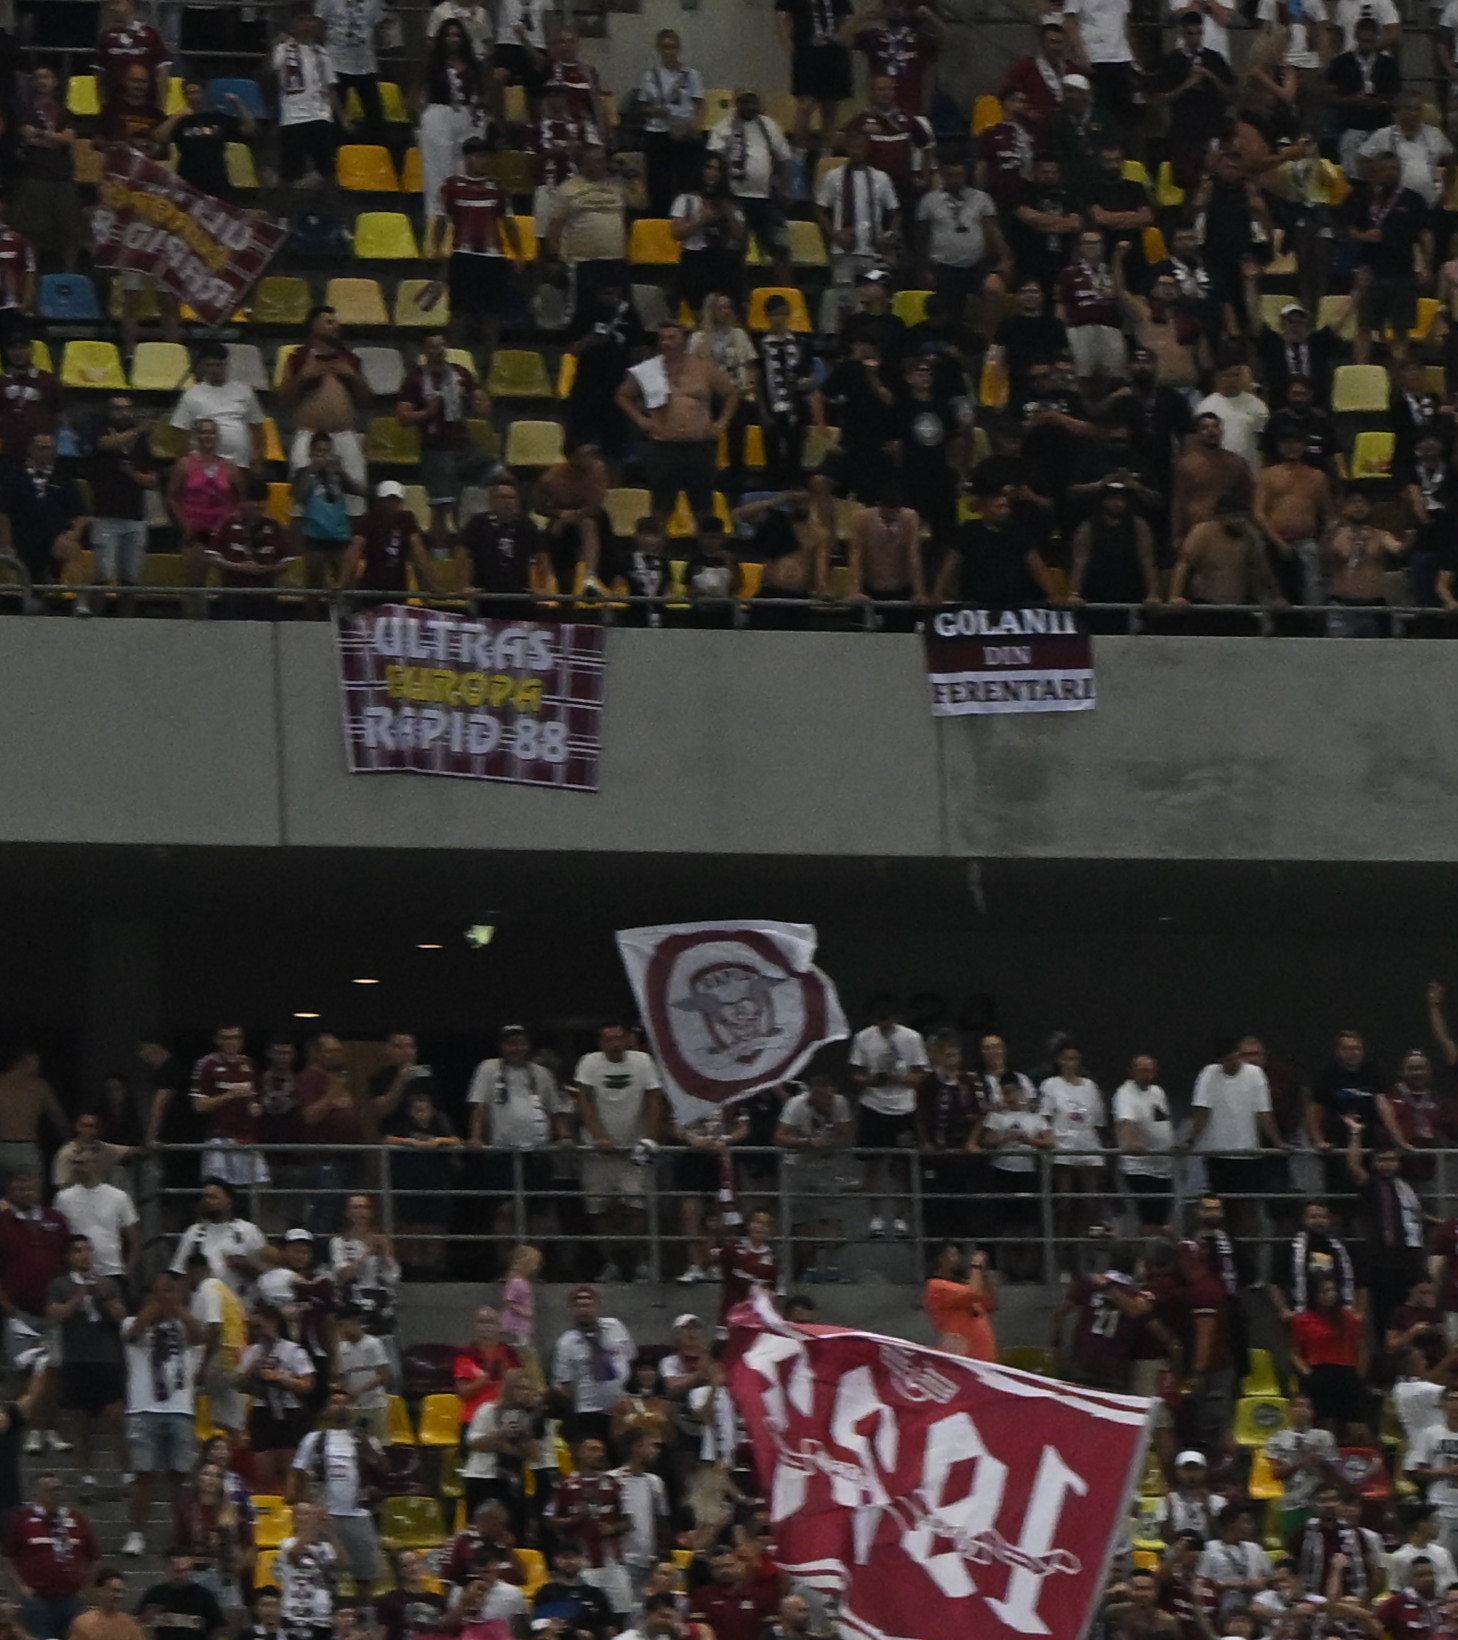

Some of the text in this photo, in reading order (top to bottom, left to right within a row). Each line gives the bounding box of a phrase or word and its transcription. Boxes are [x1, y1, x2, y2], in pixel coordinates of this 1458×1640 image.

[375, 616, 555, 671] ULTRAS
[982, 645, 1032, 666] DIN
[385, 664, 544, 713] EUROPA
[931, 677, 1098, 705] FERENTARI
[363, 705, 570, 764] RAPID 88
